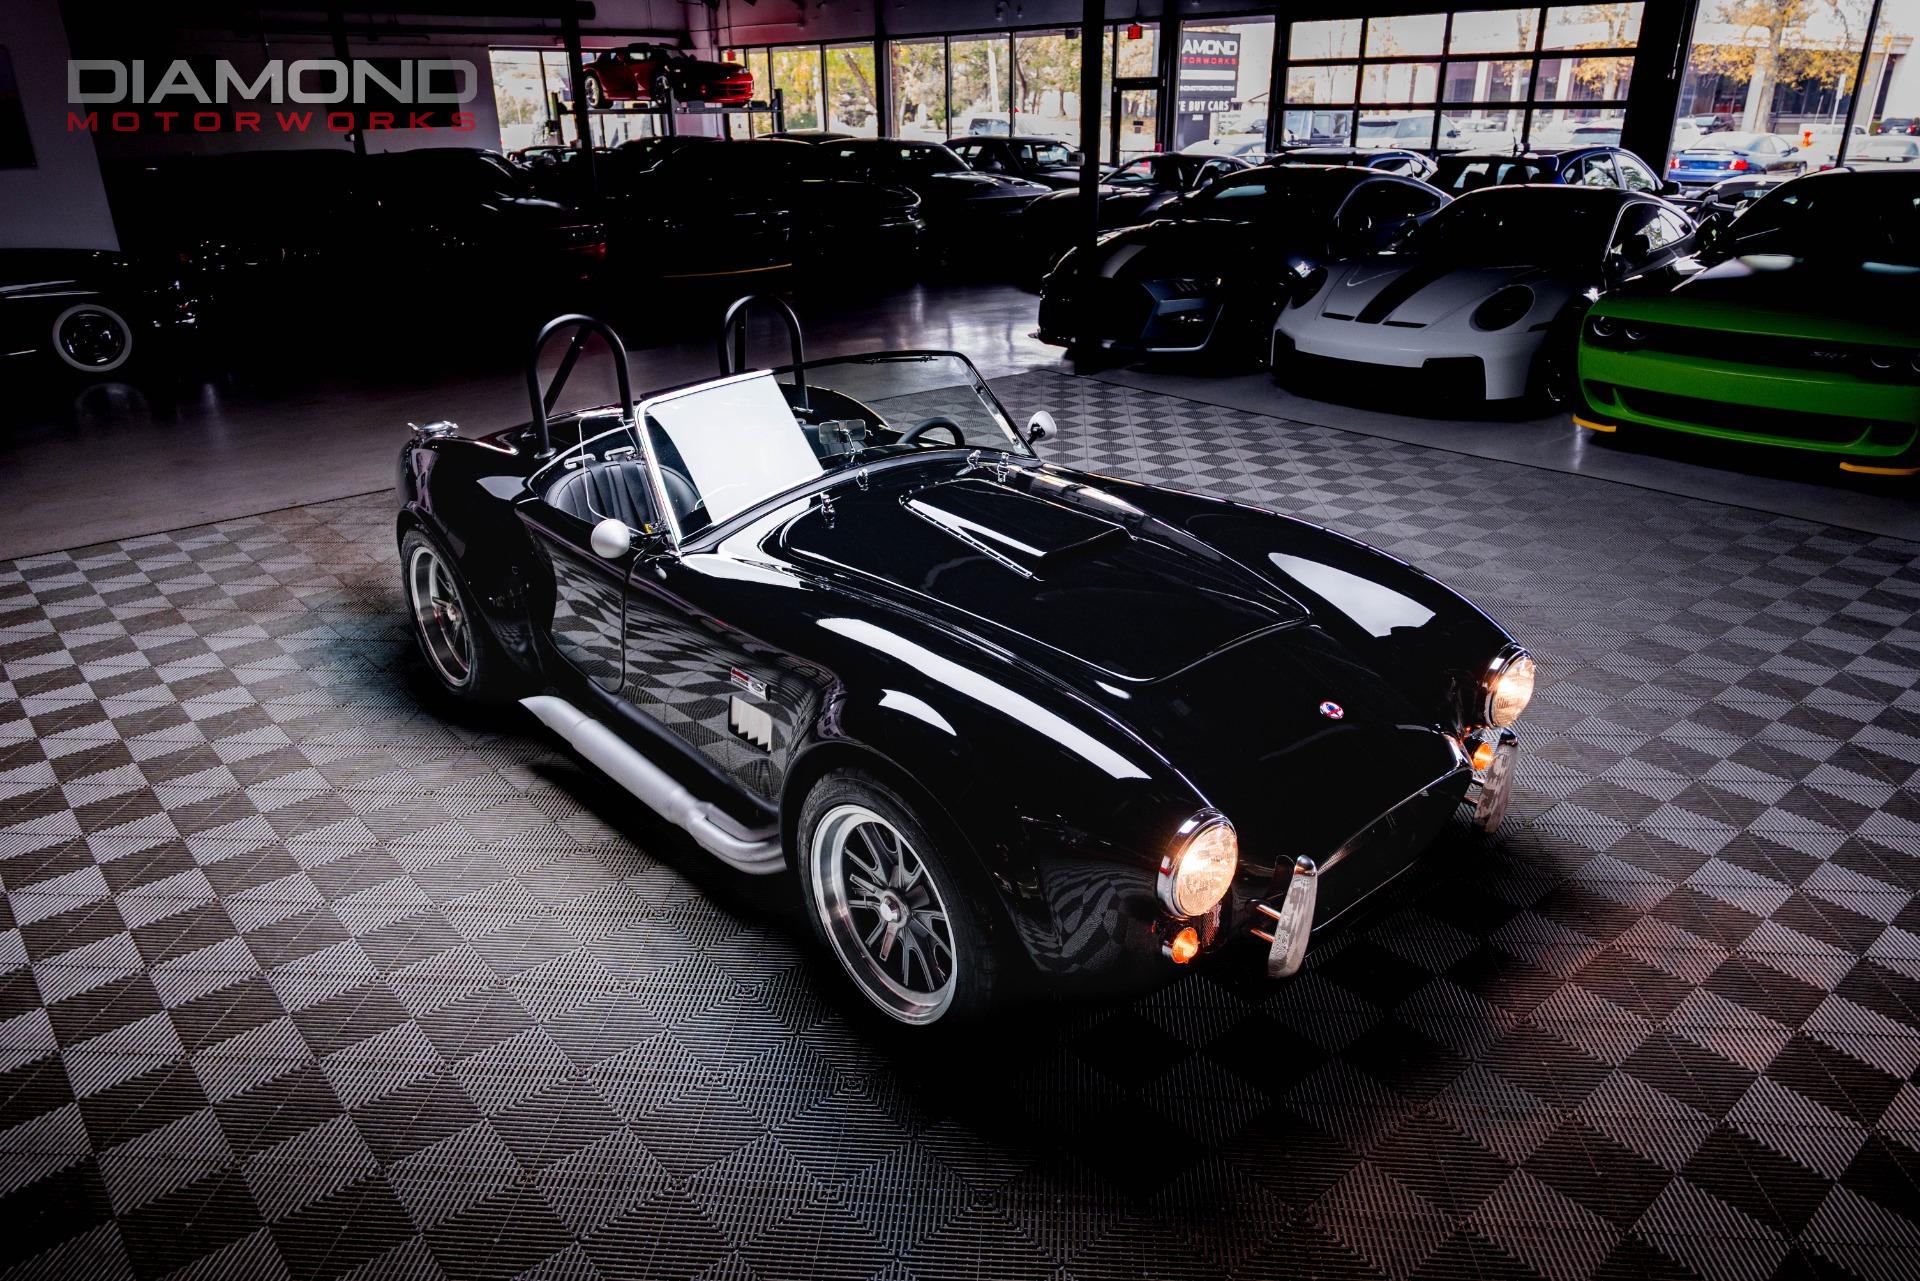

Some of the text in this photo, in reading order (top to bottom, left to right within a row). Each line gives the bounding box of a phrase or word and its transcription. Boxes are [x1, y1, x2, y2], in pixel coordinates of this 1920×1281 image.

[1179, 100, 1229, 111] E BUY CARS
